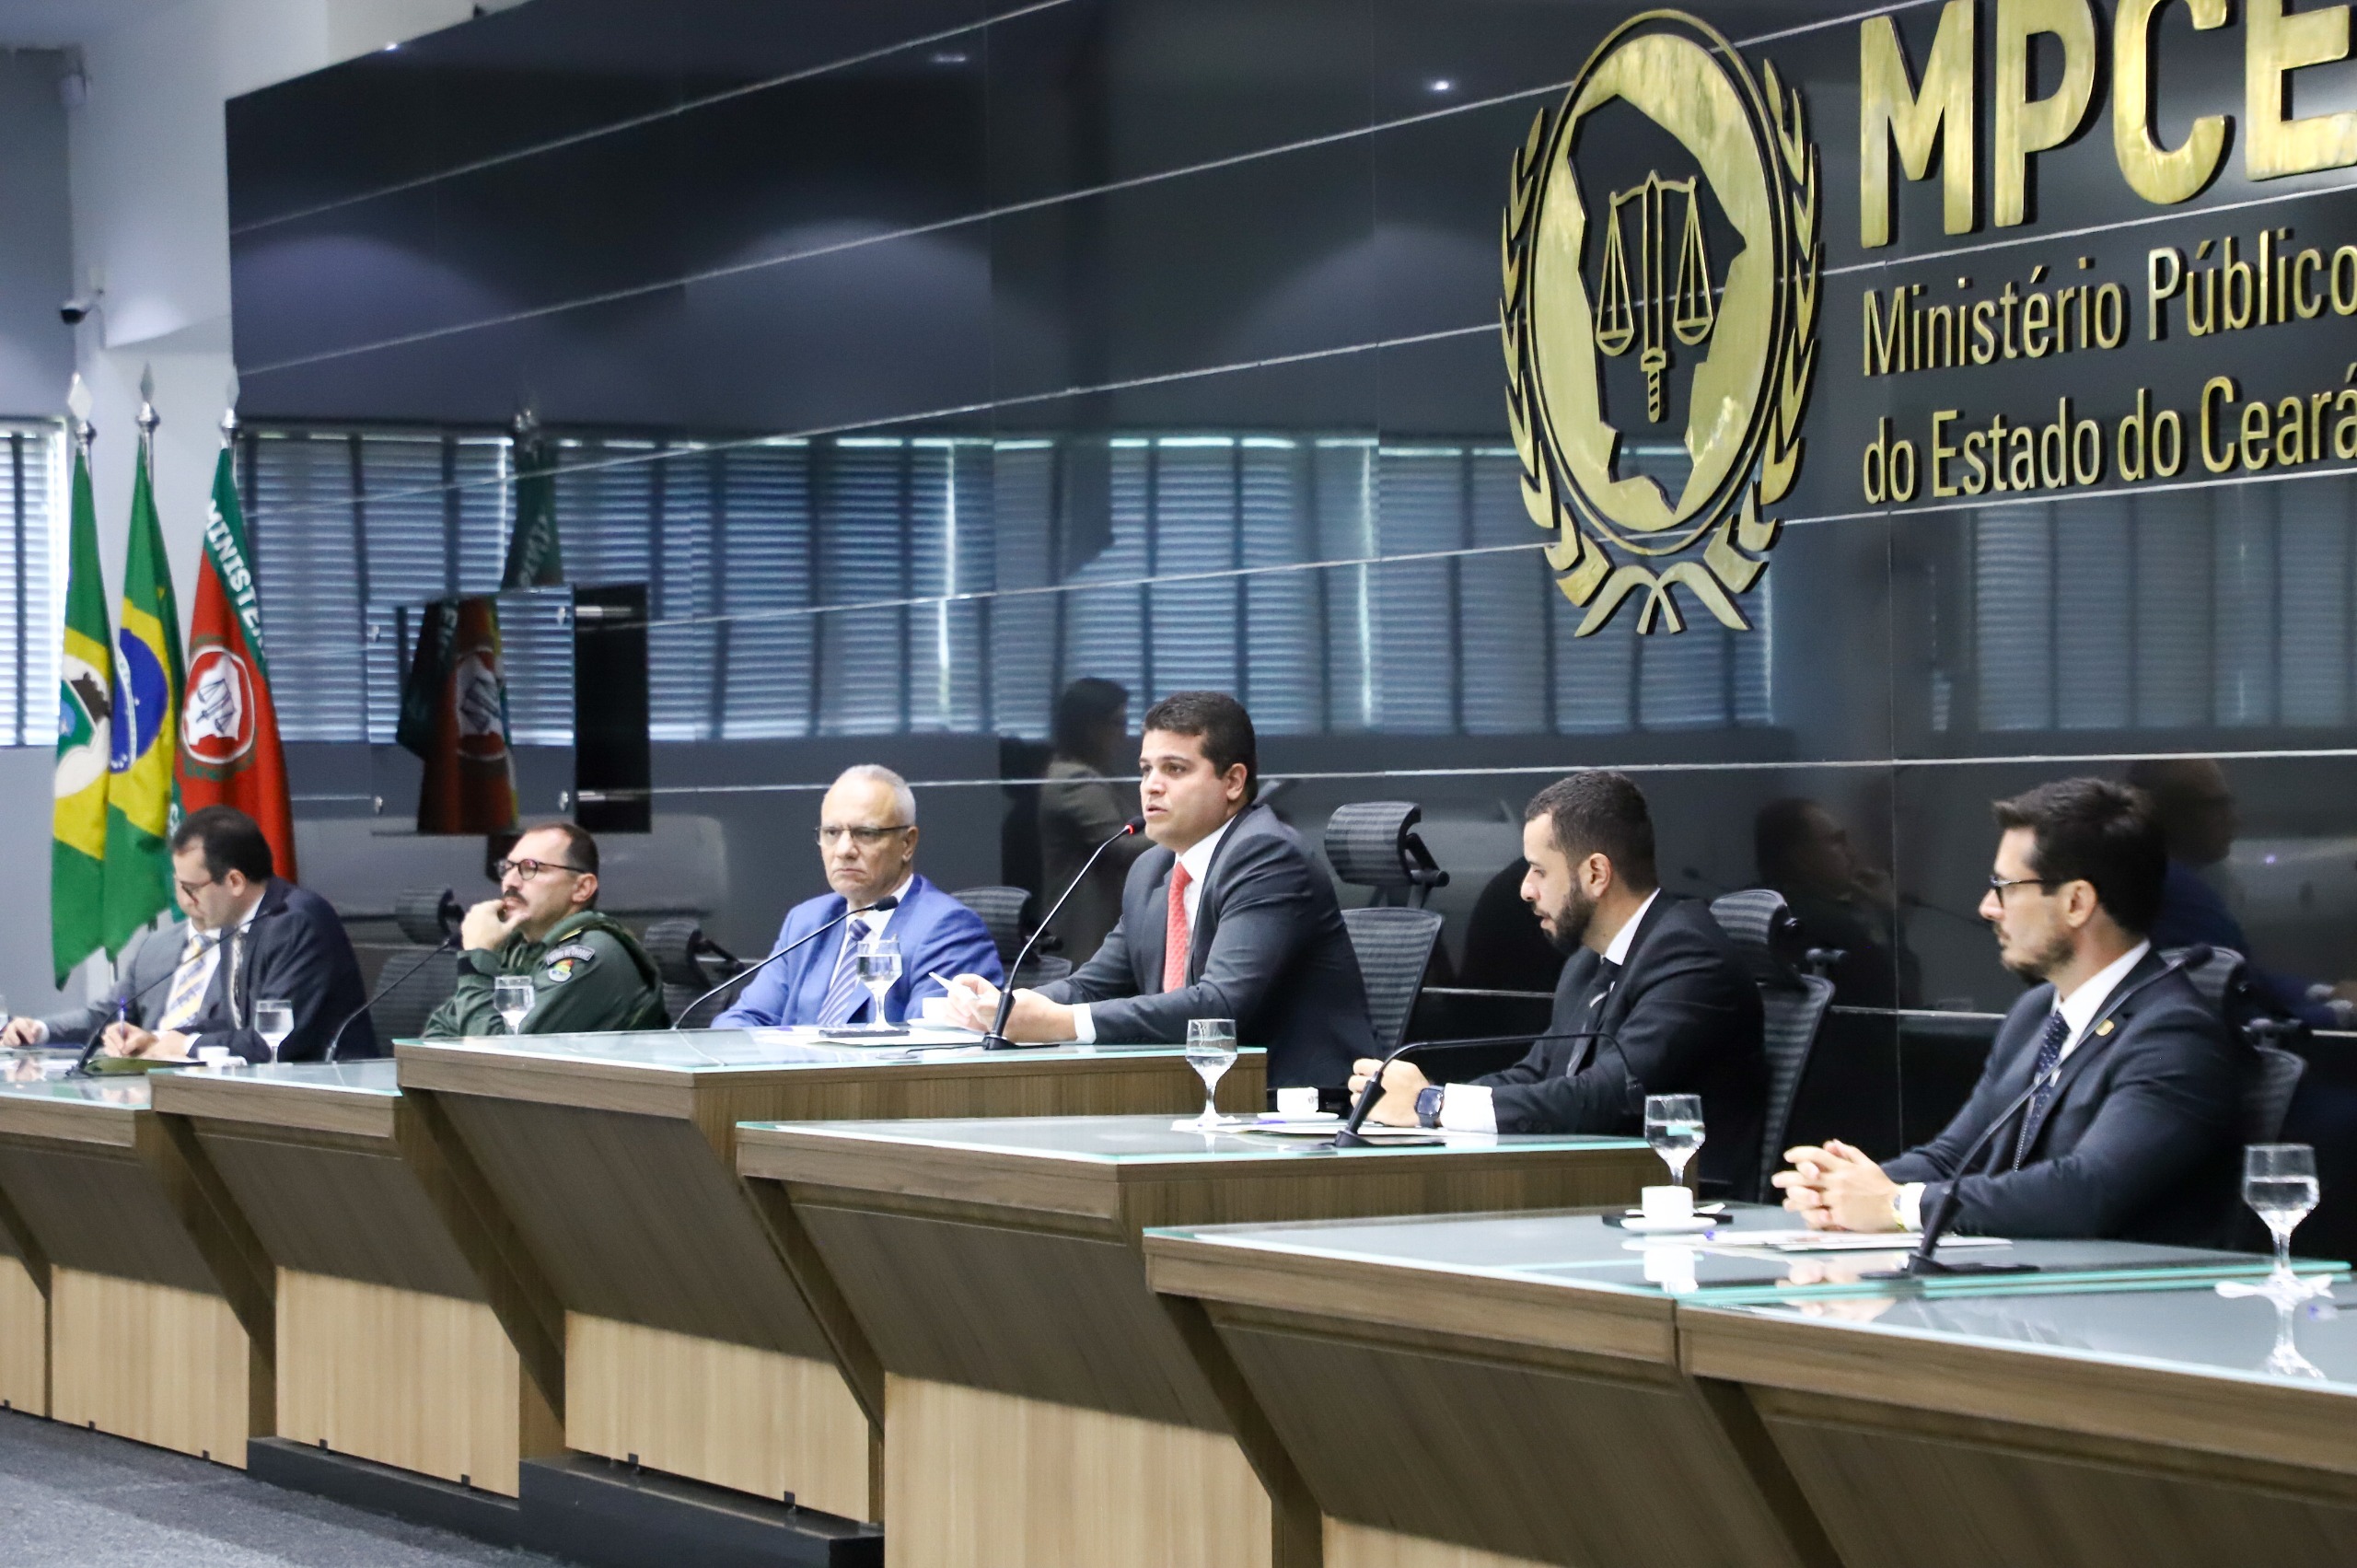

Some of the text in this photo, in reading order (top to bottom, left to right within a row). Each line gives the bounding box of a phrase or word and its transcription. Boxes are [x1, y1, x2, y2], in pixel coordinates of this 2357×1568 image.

[1860, 0, 2357, 248] MPCE
[1863, 227, 2357, 377] Ministério Público
[1863, 363, 2357, 504] do Estado do Ceará
